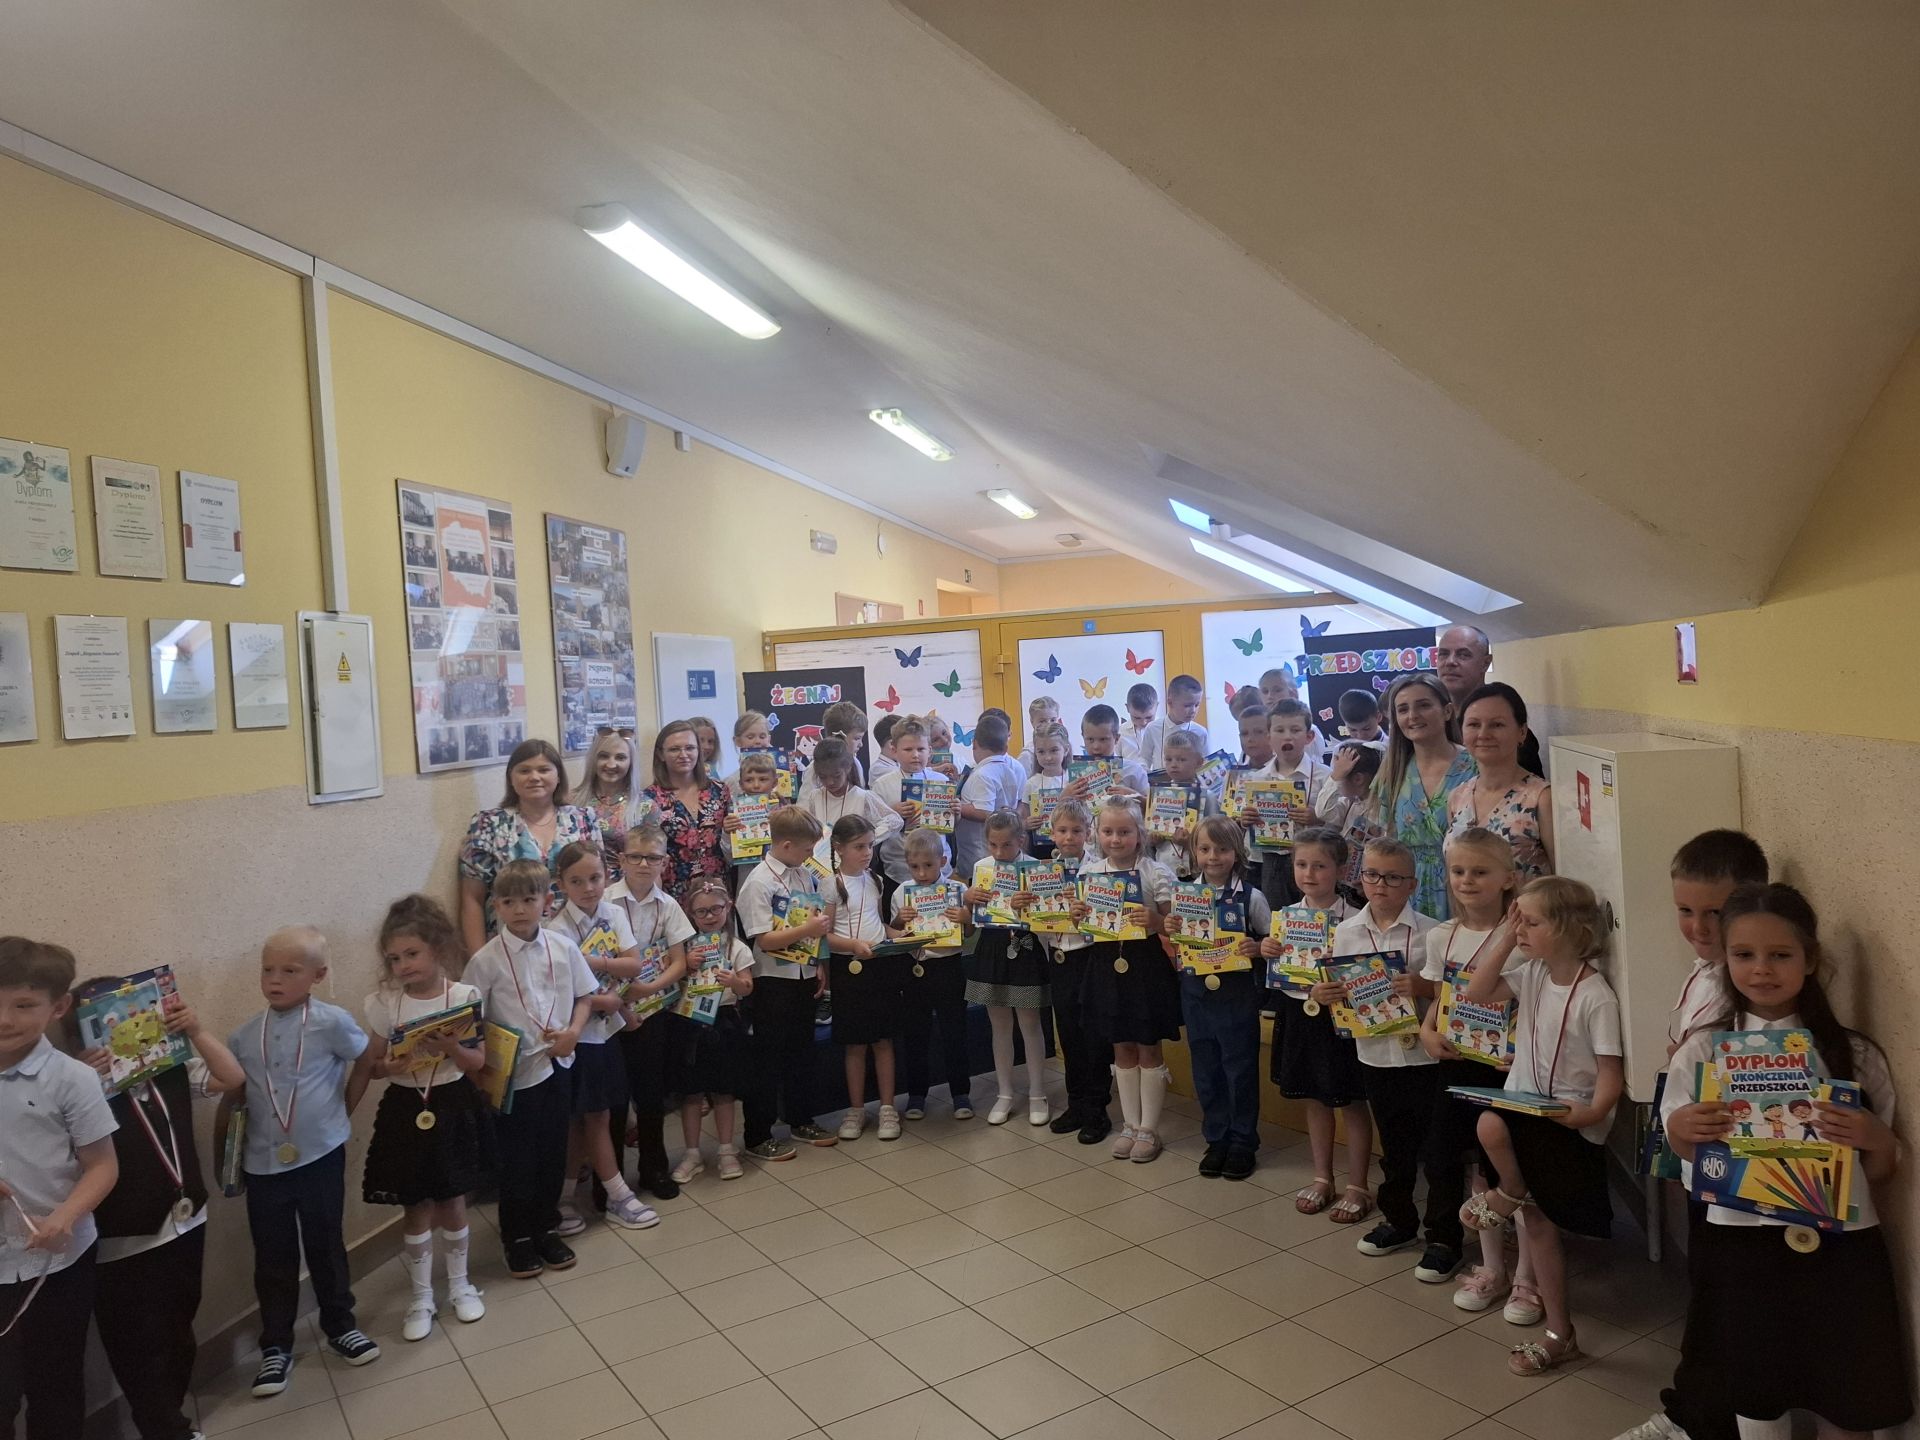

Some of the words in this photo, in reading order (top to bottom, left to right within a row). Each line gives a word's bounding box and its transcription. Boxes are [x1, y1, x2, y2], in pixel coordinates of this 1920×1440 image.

[1294, 646, 1439, 676] PRZEDSZKOLE
[771, 684, 841, 706] ŻEGNAJ
[1256, 801, 1289, 809] DYPLOM
[996, 872, 1017, 881] DYPL
[1029, 873, 1061, 881] DYPLOM
[1088, 885, 1122, 897] DYPLOM
[915, 893, 945, 903] DYPLOM
[1175, 894, 1211, 905] DYPLOM
[1286, 920, 1324, 930] DYPLOM
[1346, 969, 1387, 990] DYPLOM
[1725, 1052, 1807, 1071] DYPLOM
[1731, 1071, 1806, 1083] UKOŃCZENIA
[1730, 1082, 1811, 1094] PRZEDSZKOLA
